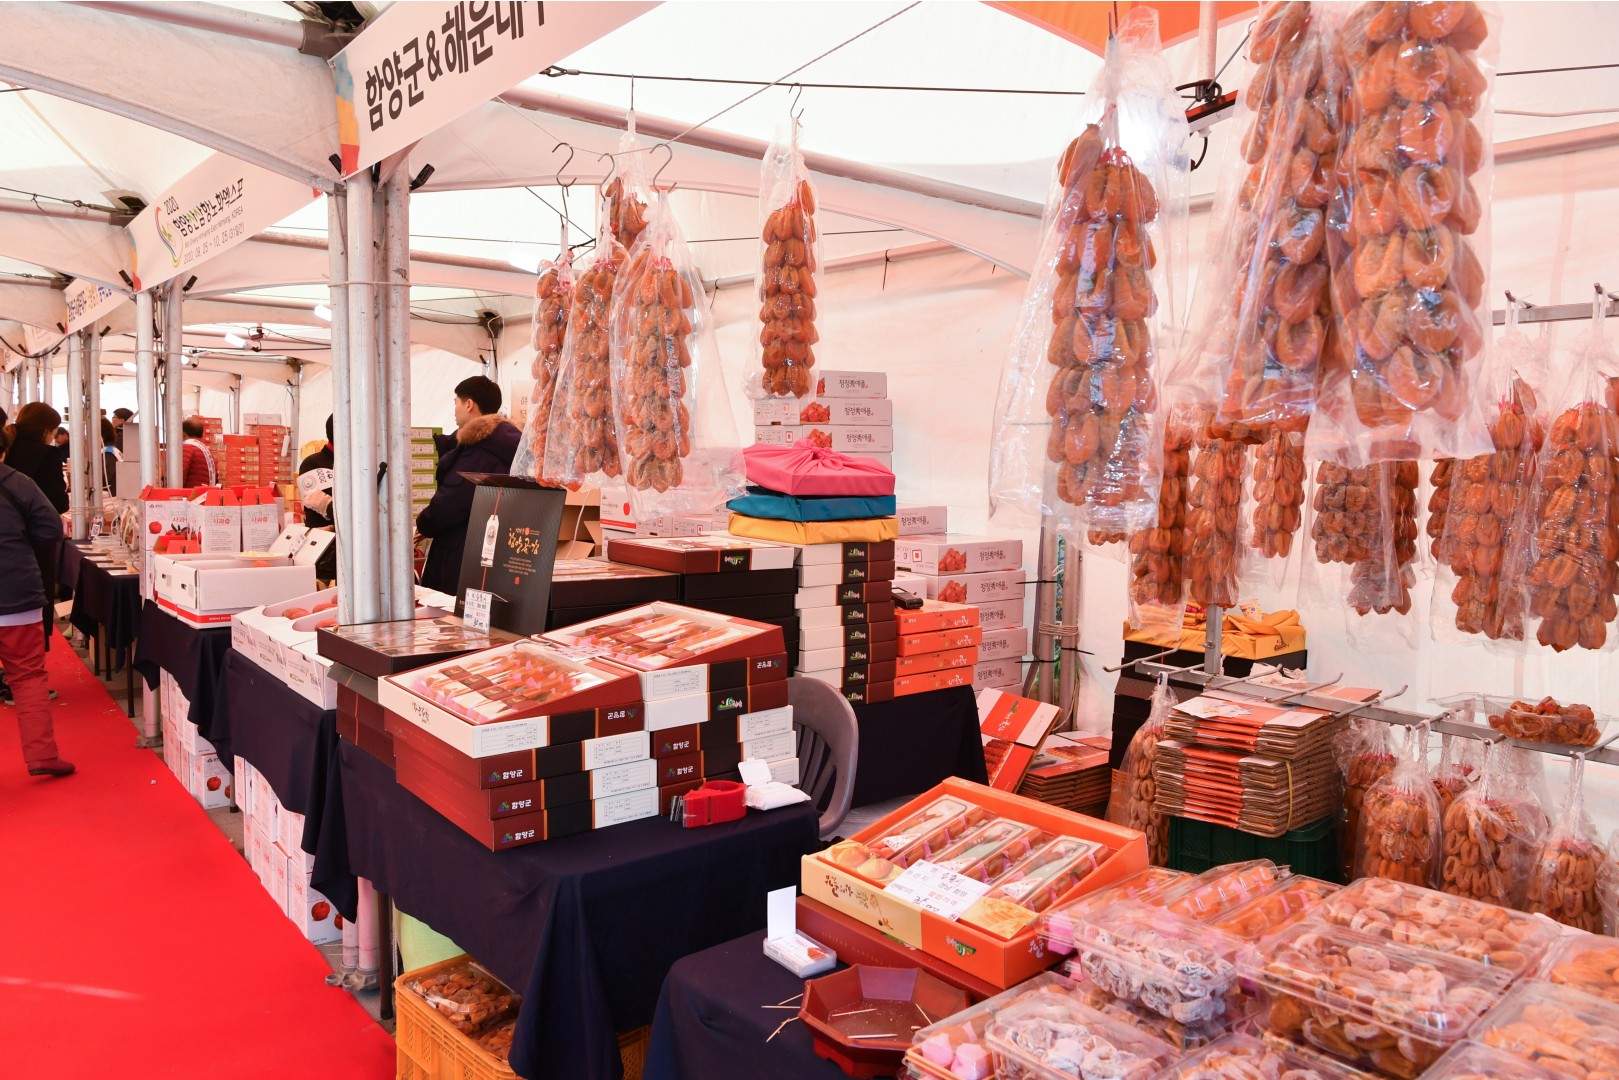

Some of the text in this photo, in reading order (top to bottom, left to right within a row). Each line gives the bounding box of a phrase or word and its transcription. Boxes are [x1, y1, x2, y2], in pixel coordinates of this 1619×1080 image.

[365, 1, 545, 132] 함양군&해운대
[164, 195, 180, 216] 2020
[172, 177, 244, 237] 함양산삼항노화엑스포
[672, 740, 690, 751] 함양군
[502, 769, 523, 780] 함양군
[676, 765, 694, 776] 함양군
[511, 799, 532, 810] 함양군
[514, 829, 535, 841] 함양군
